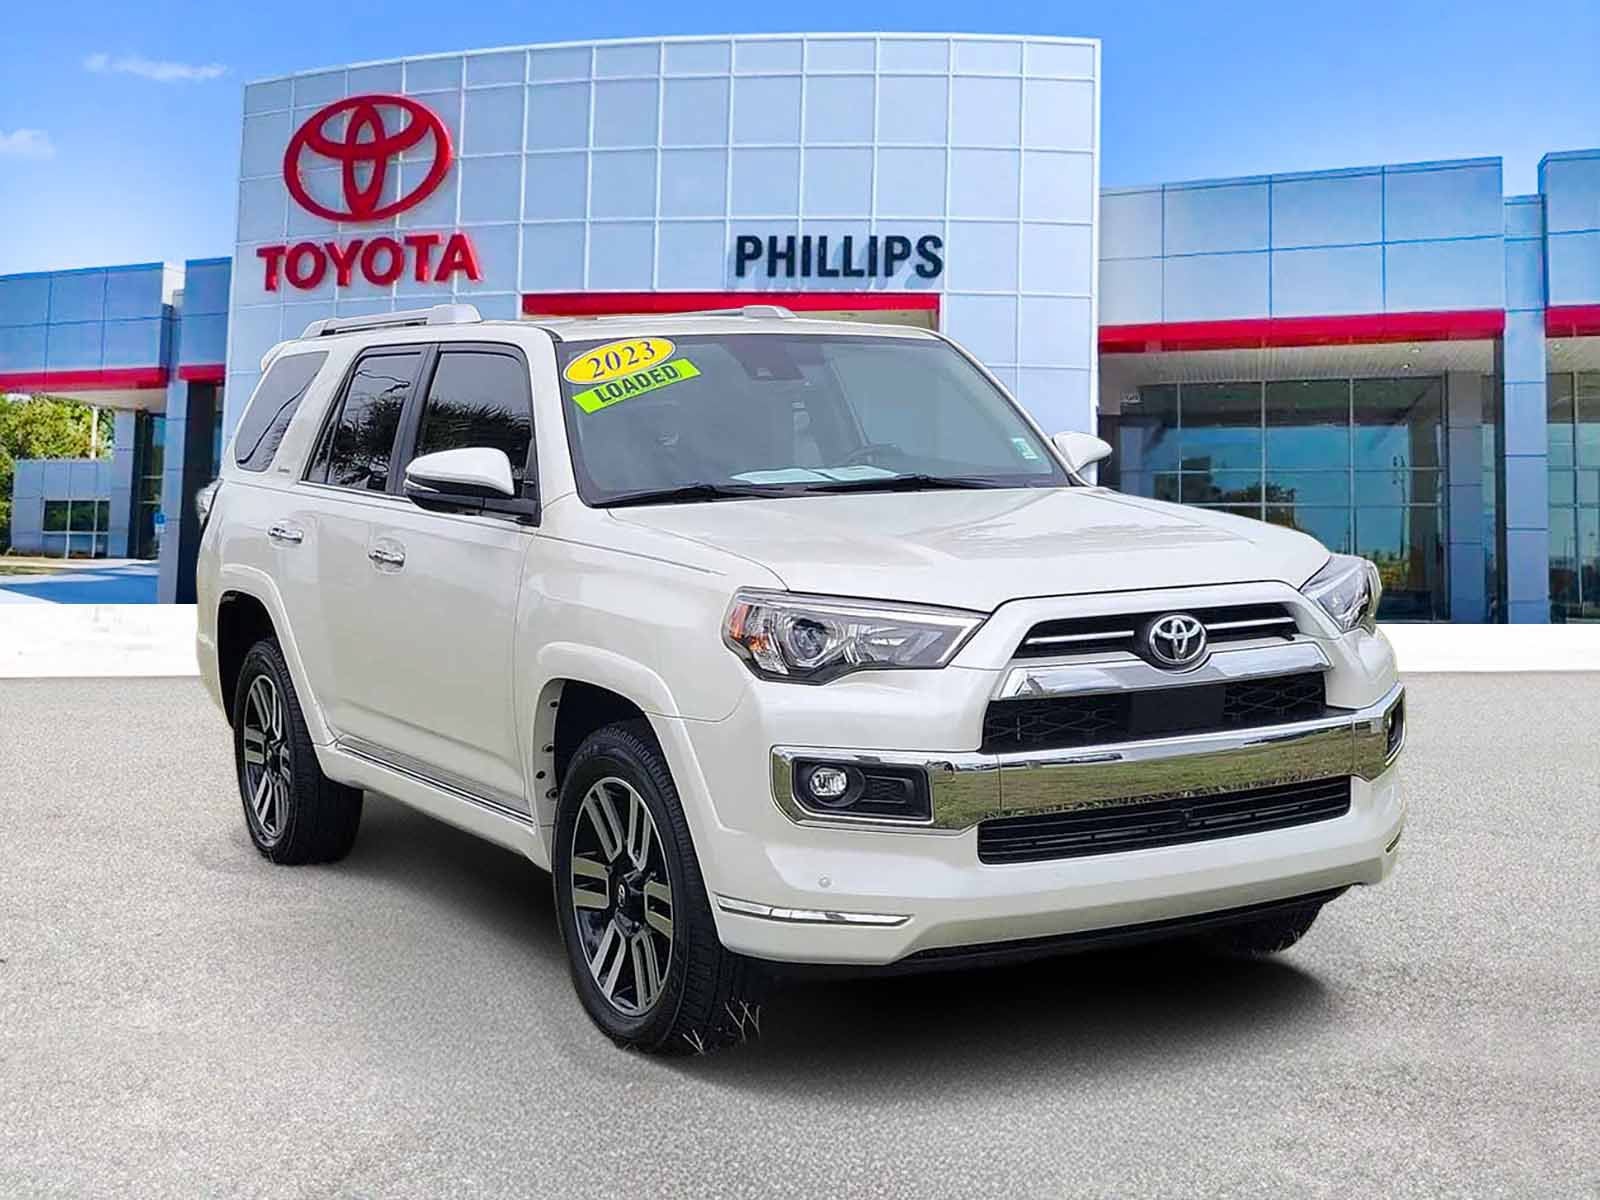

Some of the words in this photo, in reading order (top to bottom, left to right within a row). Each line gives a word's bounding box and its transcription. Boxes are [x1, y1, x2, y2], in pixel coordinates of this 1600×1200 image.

[256, 233, 480, 291] TOYOTA
[735, 234, 943, 279] PHILLIPS
[587, 341, 656, 378] 2023
[593, 364, 681, 403] LOADED
